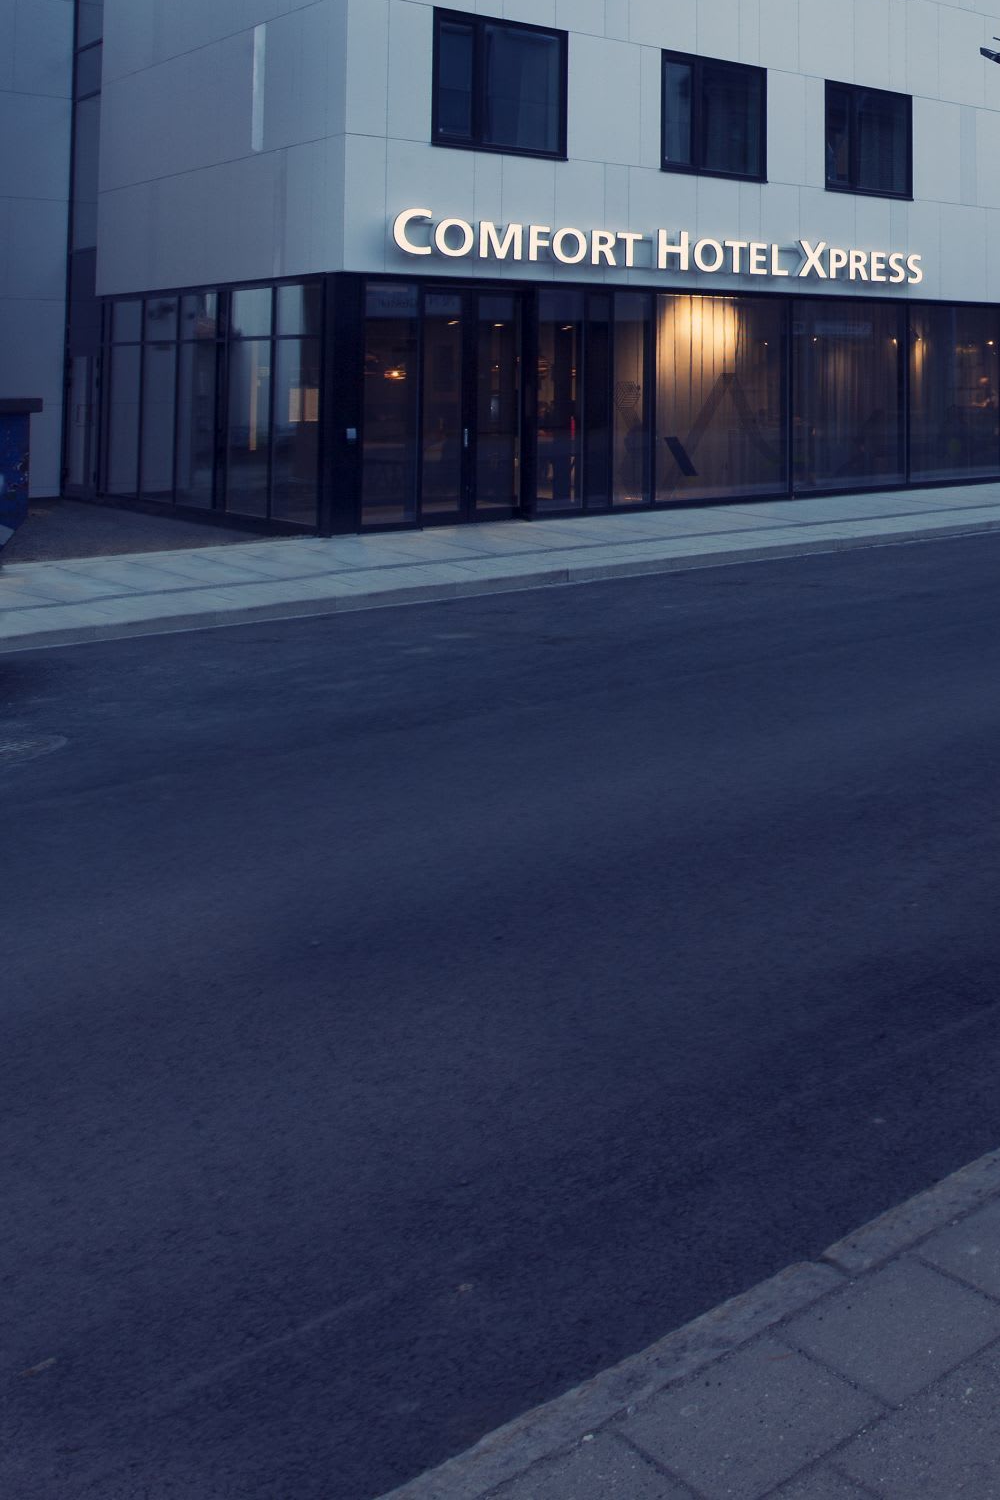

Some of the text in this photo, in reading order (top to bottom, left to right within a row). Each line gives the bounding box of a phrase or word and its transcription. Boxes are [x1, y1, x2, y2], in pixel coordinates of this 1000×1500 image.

[392, 208, 925, 286] COMFORT HOTEL XPRESS
